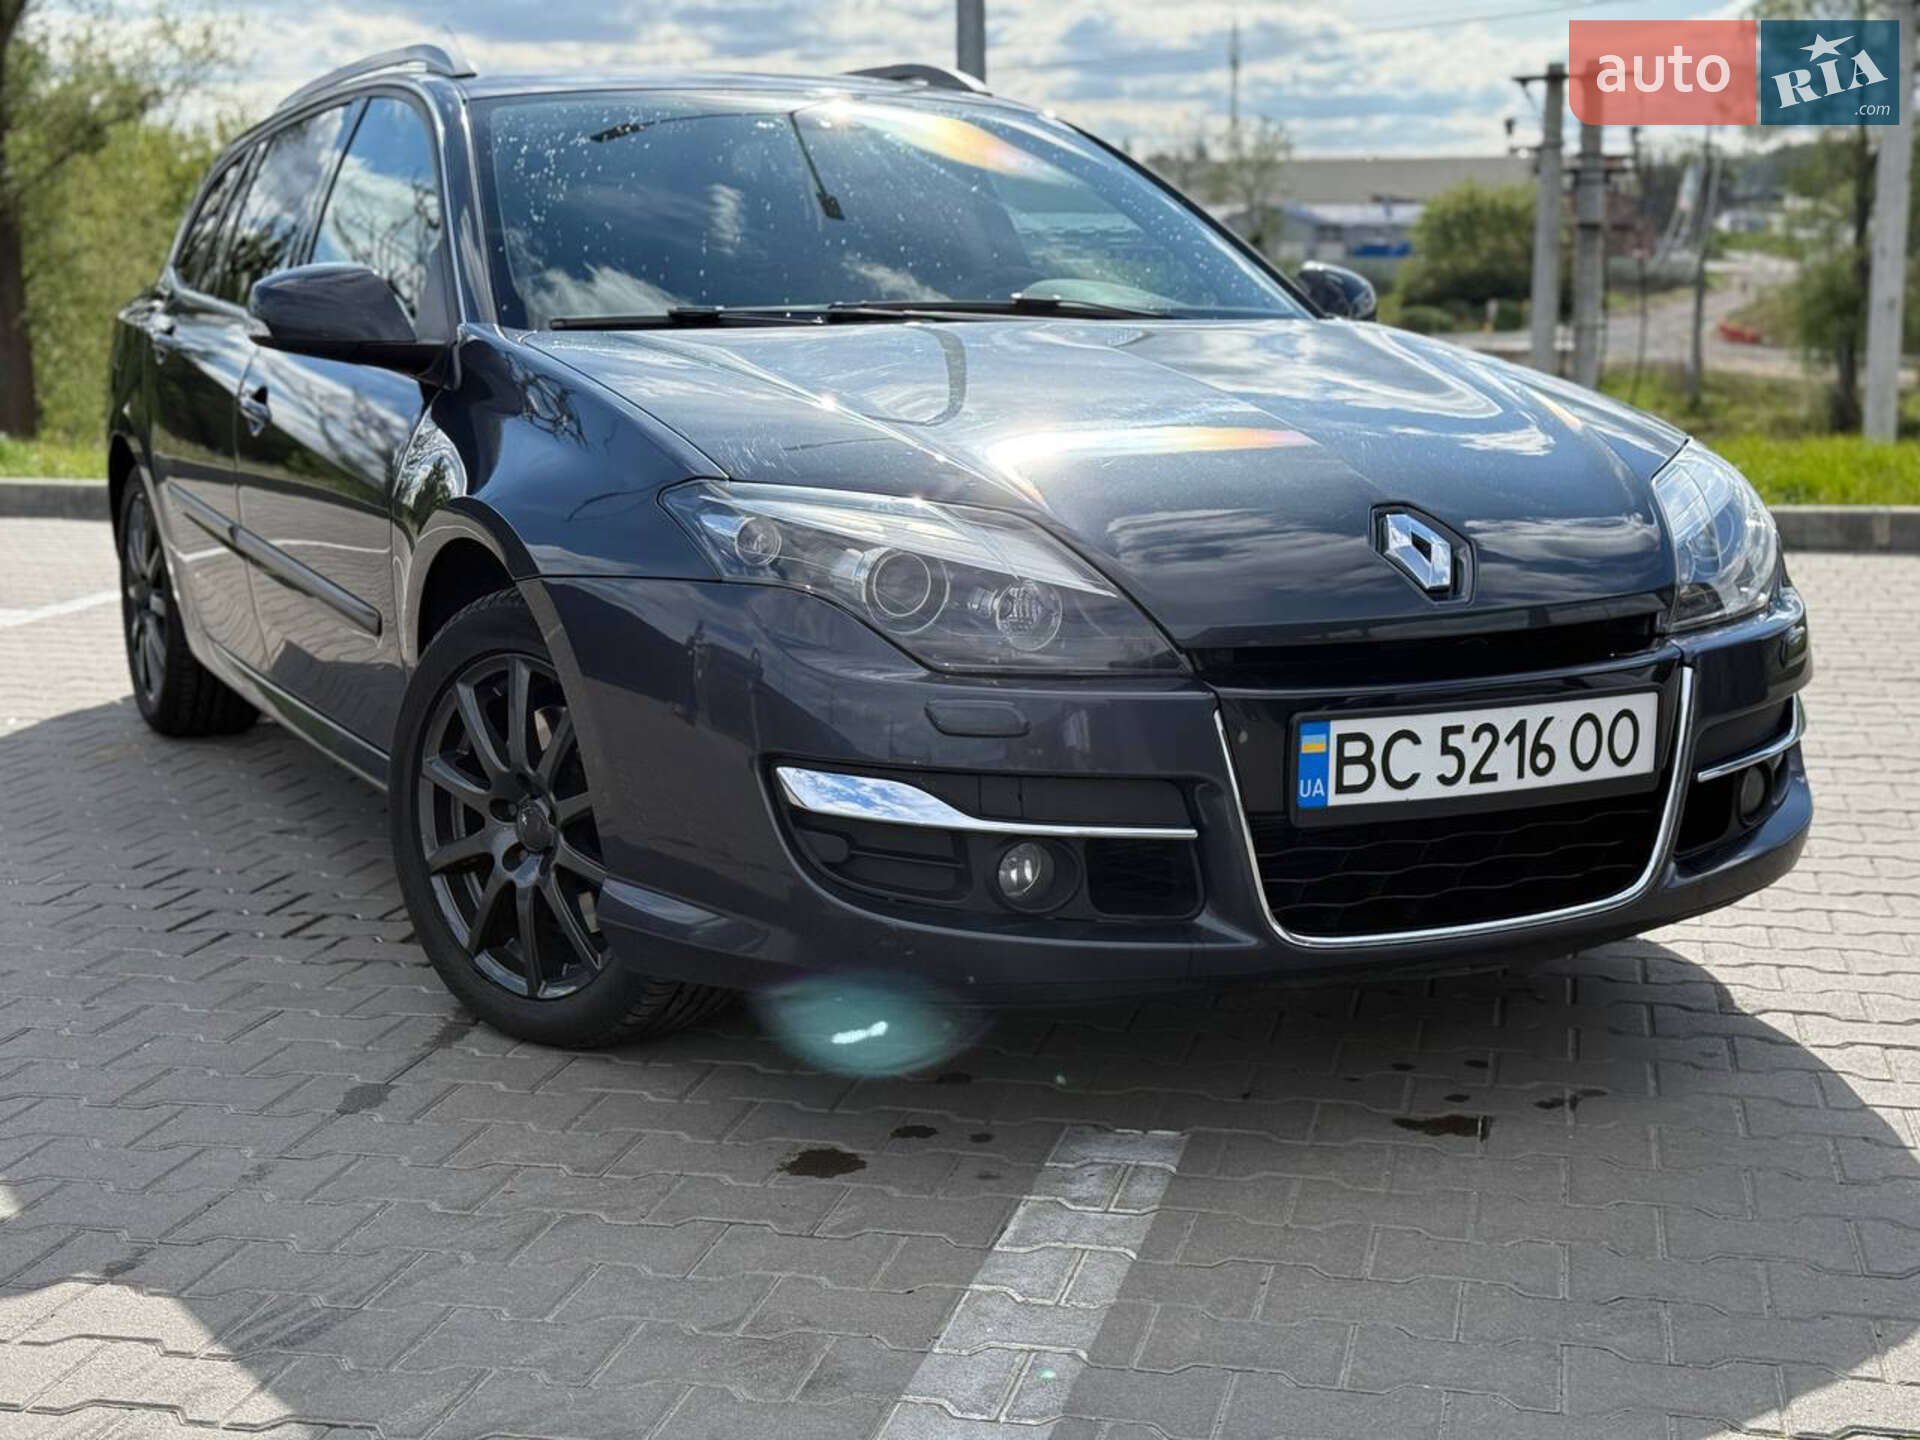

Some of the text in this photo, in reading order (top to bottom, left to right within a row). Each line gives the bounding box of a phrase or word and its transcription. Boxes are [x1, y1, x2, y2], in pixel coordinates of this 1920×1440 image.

[1335, 728, 1422, 795] BC
[1436, 716, 1556, 787] 5216
[1299, 778, 1325, 798] UA
